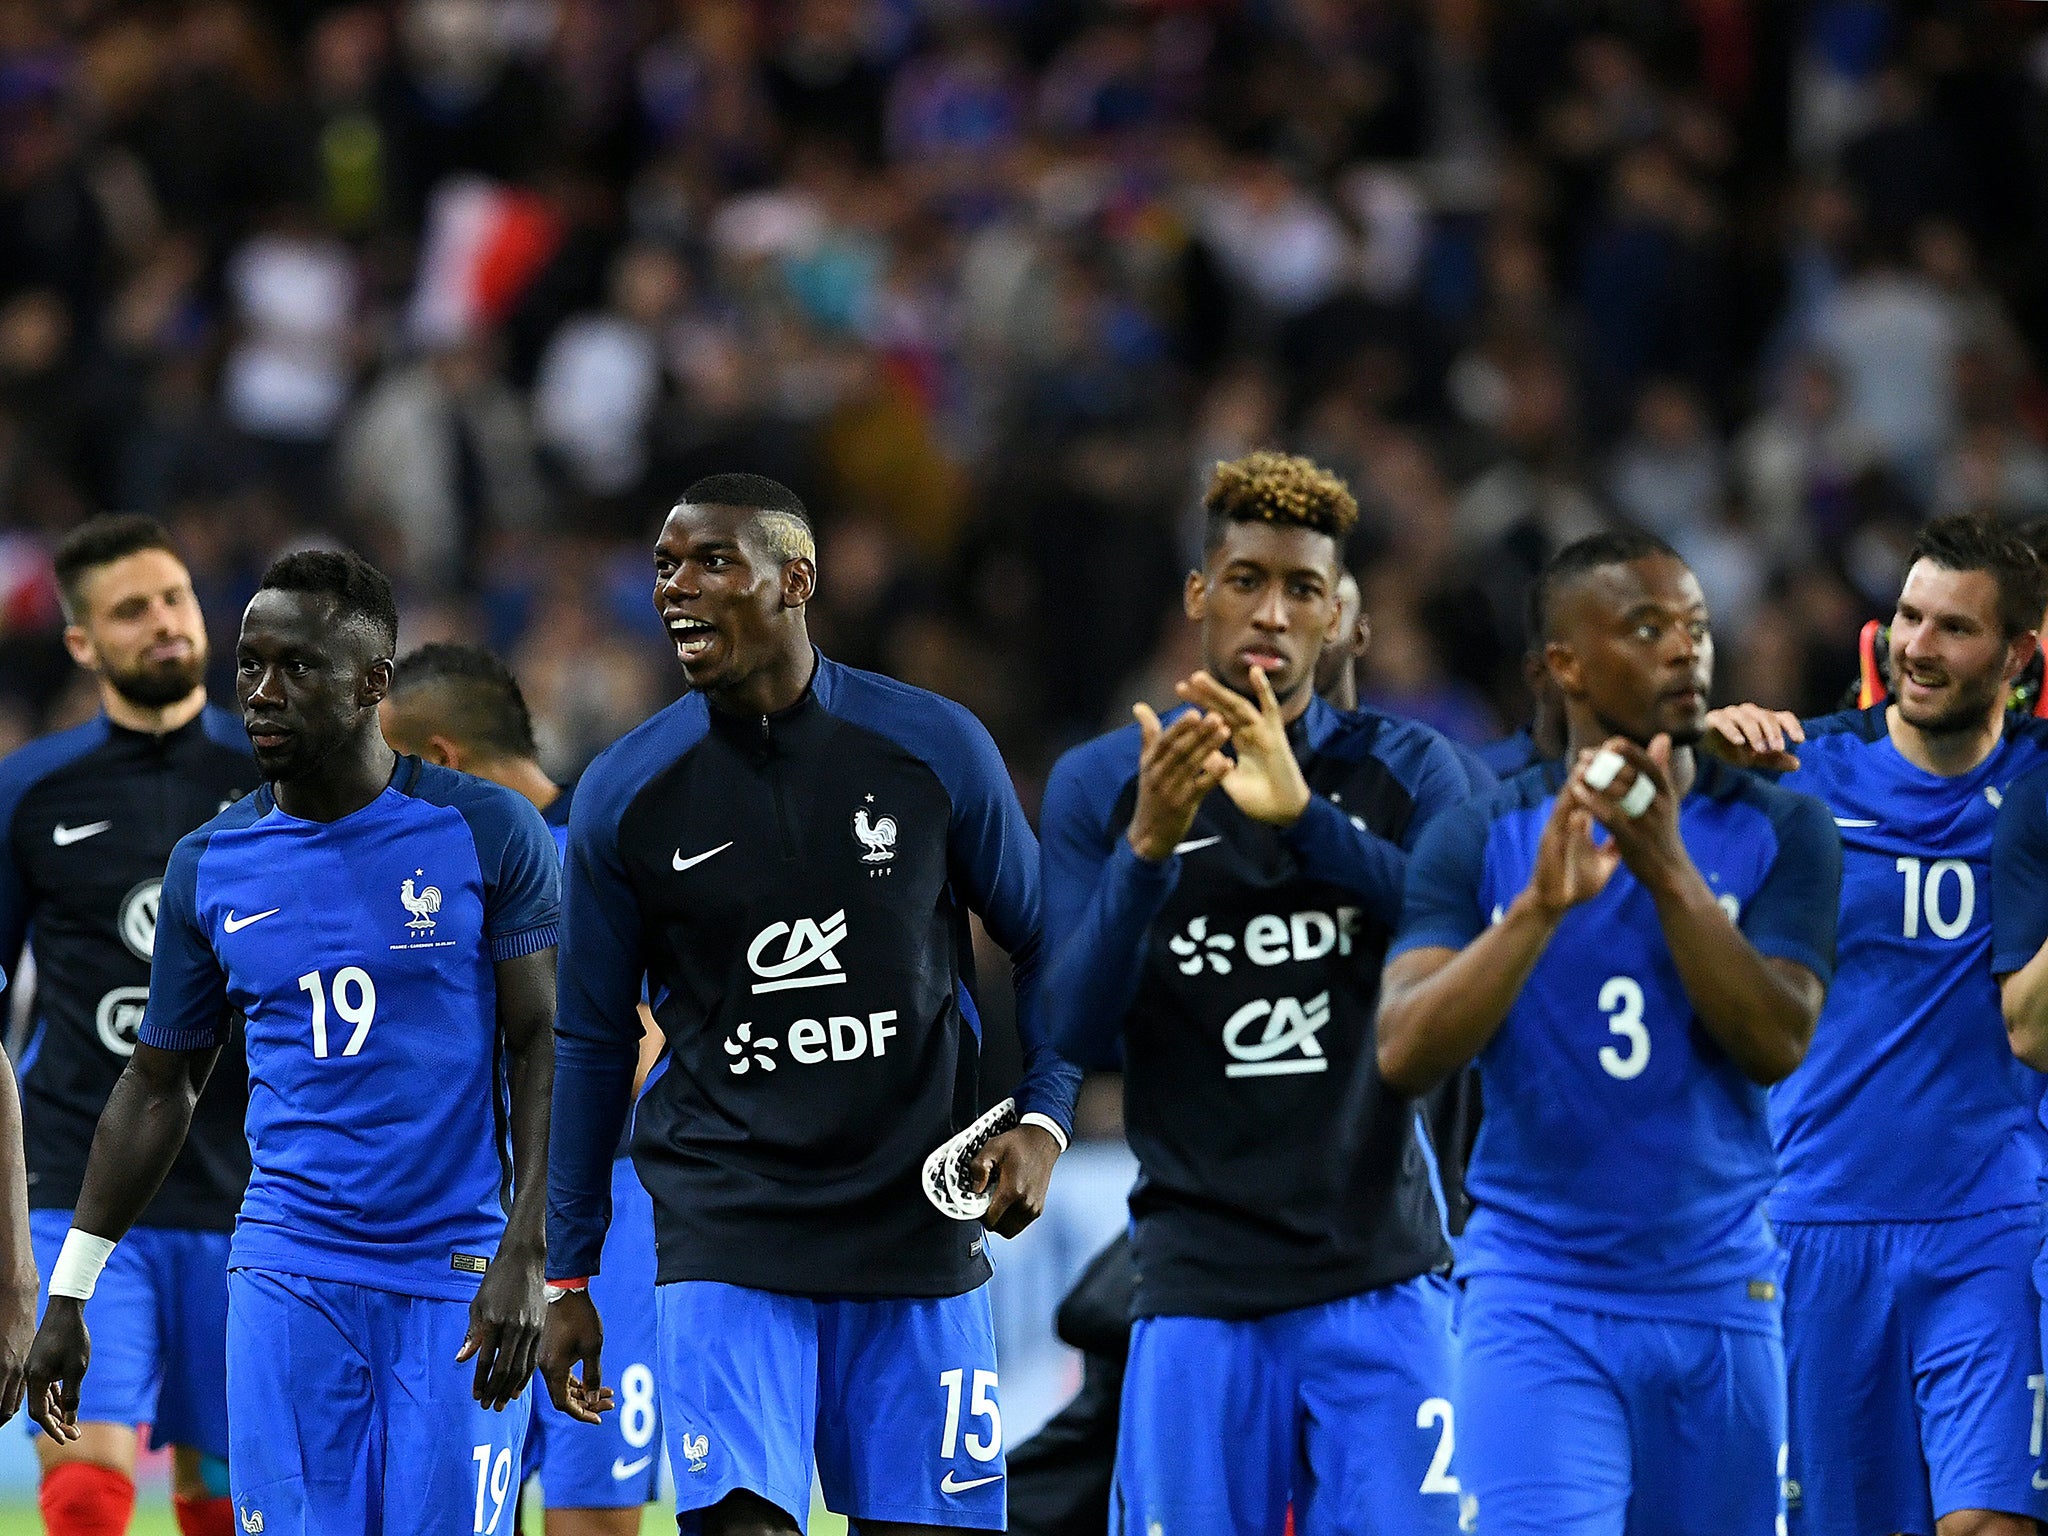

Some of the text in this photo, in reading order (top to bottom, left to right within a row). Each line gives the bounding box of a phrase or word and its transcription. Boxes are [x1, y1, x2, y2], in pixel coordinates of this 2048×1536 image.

[1896, 857, 1975, 940] 10
[298, 966, 377, 1058] 19
[1598, 976, 1651, 1080] 3
[620, 1363, 656, 1448] 8
[939, 1368, 1003, 1463] 15
[472, 1443, 513, 1536] 19
